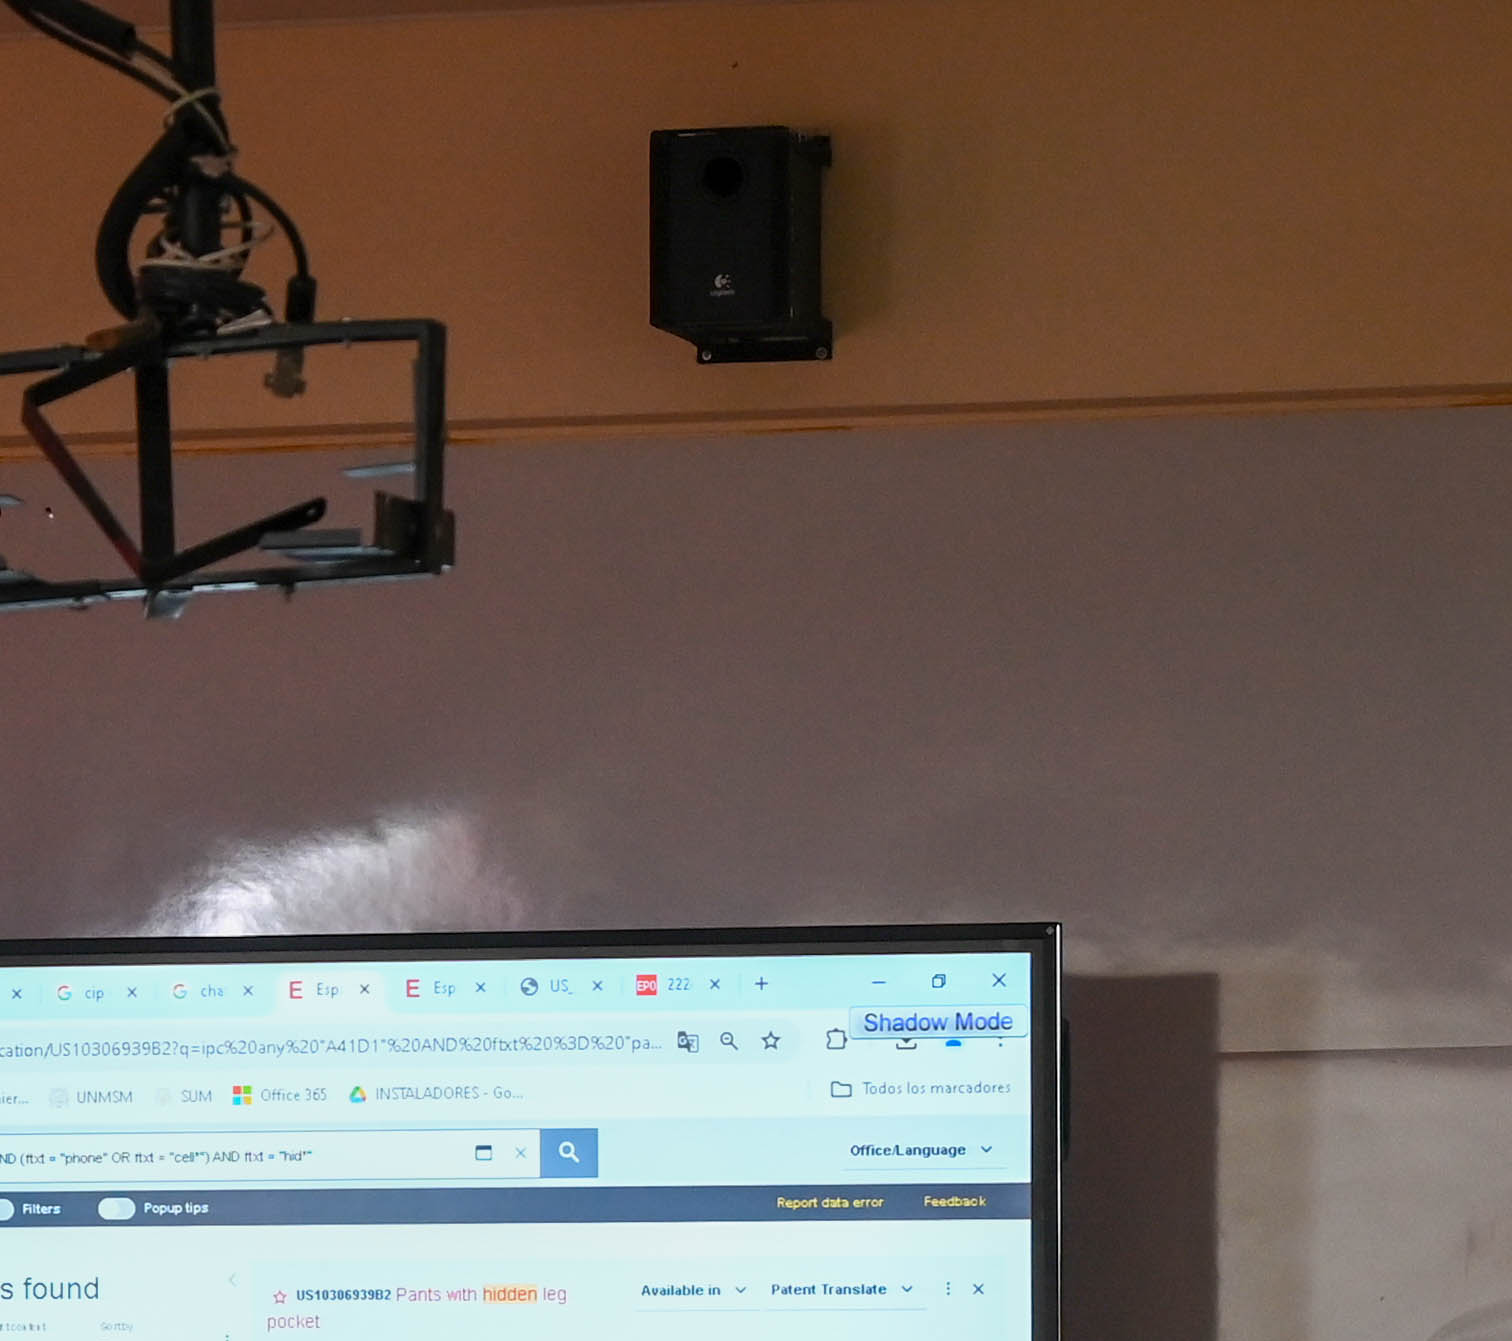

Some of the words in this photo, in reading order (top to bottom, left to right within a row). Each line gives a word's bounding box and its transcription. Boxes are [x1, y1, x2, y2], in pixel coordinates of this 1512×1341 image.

[863, 1012, 948, 1033] Shadow
[955, 1011, 1013, 1032] Mode
[260, 1088, 301, 1102] Office
[305, 1087, 327, 1102] 365
[375, 1085, 479, 1101] INSTALADORES
[492, 1085, 524, 1100] Go...
[863, 1081, 903, 1095] Todos
[906, 1081, 926, 1095] los
[930, 1080, 1011, 1095] marcadores
[76, 1089, 133, 1104] UNMSM
[181, 1089, 212, 1103] SUM
[850, 1144, 967, 1159] Office/Language
[144, 1202, 183, 1216] Popup
[185, 1201, 209, 1216] tips
[777, 1196, 818, 1211] Report
[821, 1196, 850, 1208] data
[853, 1198, 885, 1208] error
[924, 1195, 987, 1207] Feedback
[22, 1203, 61, 1215] Filters
[24, 1276, 99, 1300] found
[641, 1284, 704, 1297] Available
[708, 1286, 721, 1296] in
[771, 1283, 816, 1296] Patent
[822, 1283, 887, 1296] Translate
[296, 1288, 392, 1301] US10306939B2
[396, 1287, 441, 1302] Pants
[446, 1287, 478, 1302] with
[483, 1287, 538, 1302] hidden
[543, 1287, 567, 1305] leg
[267, 1314, 321, 1333] pocket
